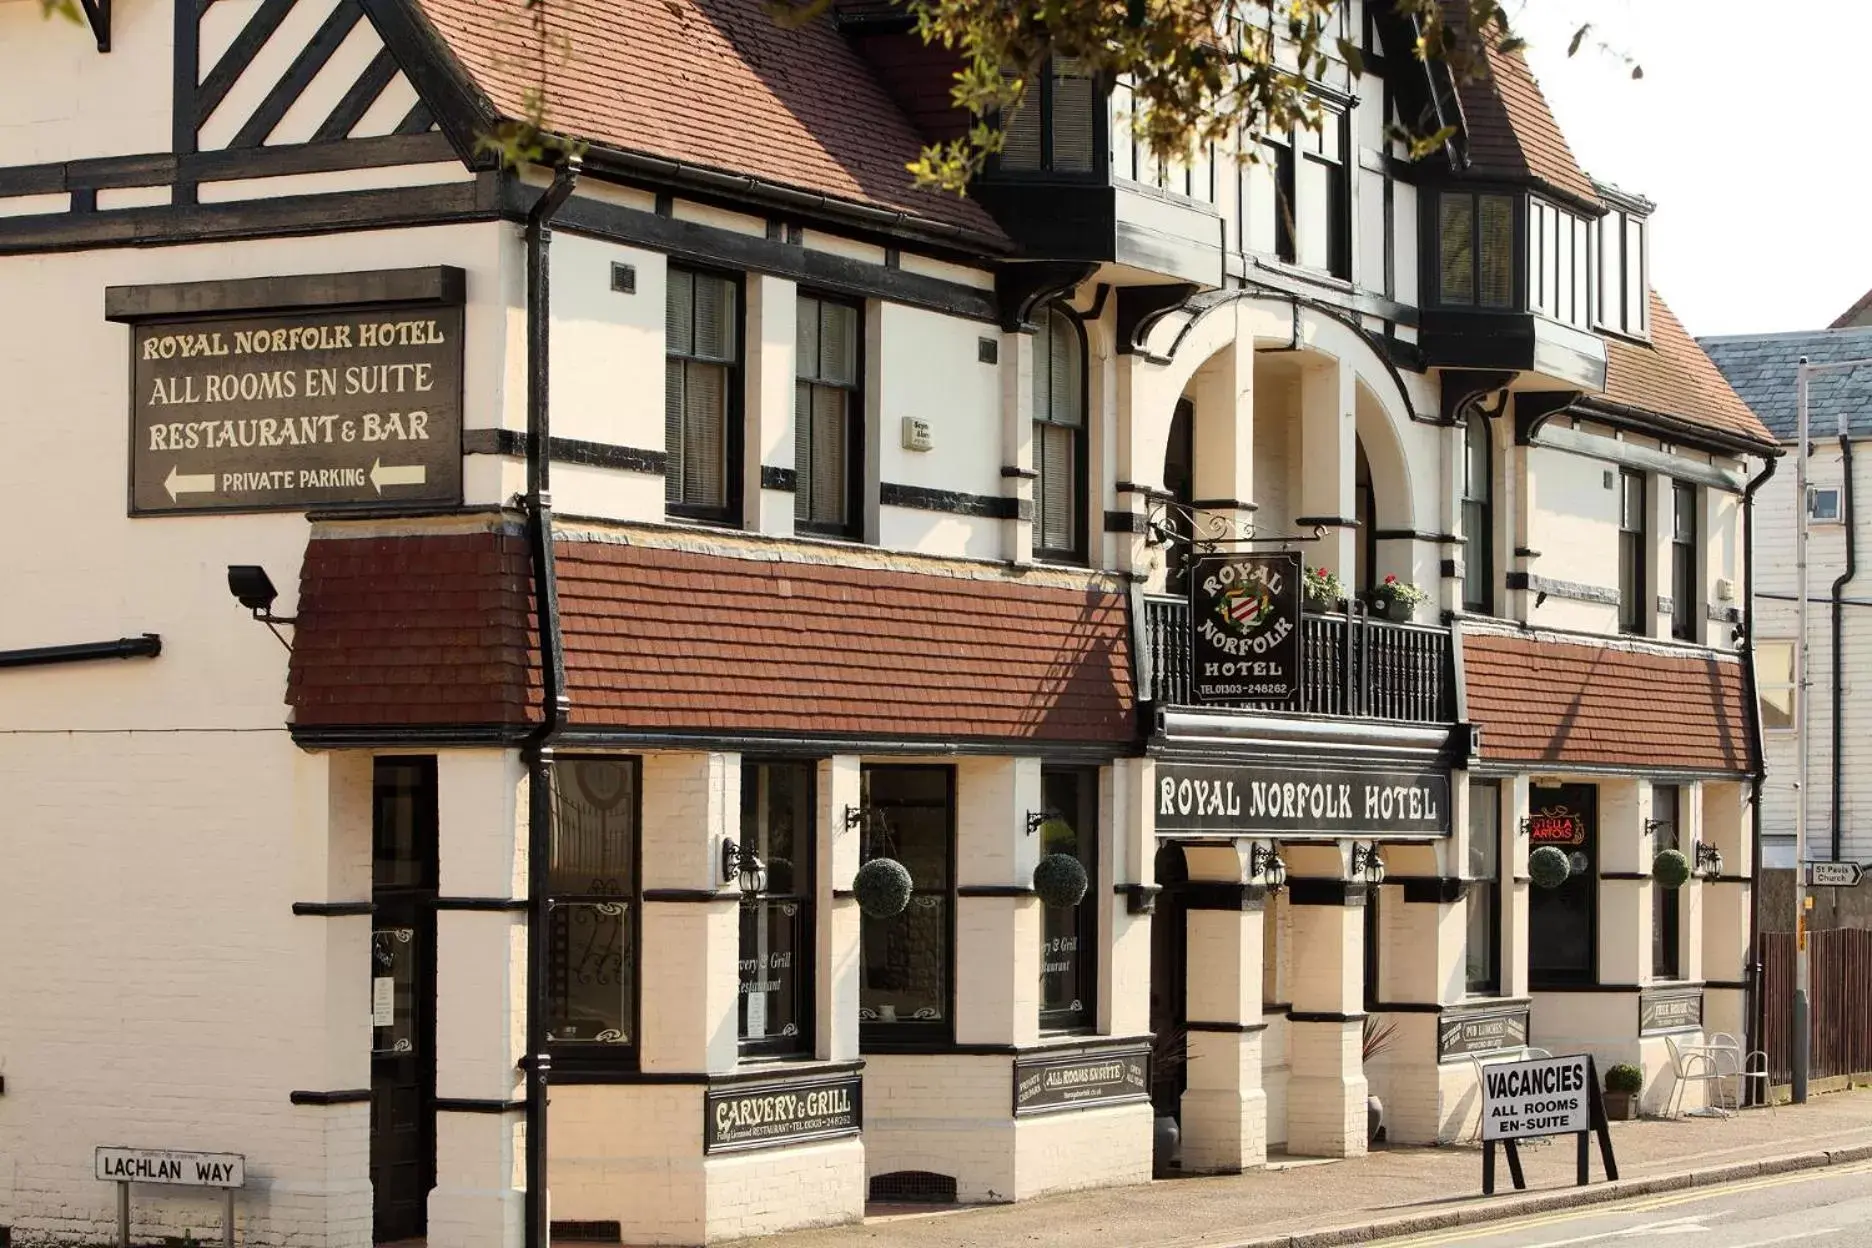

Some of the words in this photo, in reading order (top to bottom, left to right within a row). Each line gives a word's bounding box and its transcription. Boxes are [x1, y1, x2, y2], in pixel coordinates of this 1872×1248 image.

[143, 333, 229, 361] ROYAL
[234, 325, 352, 355] NORFOLK
[358, 320, 445, 347] HOTEL
[148, 377, 201, 406] ALL
[205, 371, 297, 403] ROOMS
[305, 368, 337, 397] EN
[344, 363, 434, 394] SUITE
[149, 414, 340, 451] RESTAURANT
[341, 420, 357, 442] &
[362, 410, 430, 441] BAR
[222, 470, 295, 492] PRIVATE
[299, 468, 366, 489] PARKING
[1202, 562, 1283, 597] ROYAL
[1197, 616, 1293, 656] NORFOLK
[1204, 661, 1282, 677] HOTEL
[1160, 776, 1240, 816] ROYAL
[1250, 781, 1353, 818] NORFOLK
[1364, 785, 1437, 820] HOTEL
[1533, 828, 1572, 838] ARTOIS
[1816, 865, 1825, 873] St
[1818, 874, 1846, 882] Church
[770, 952, 791, 968] Grill
[1046, 1071, 1062, 1087] ALL
[1063, 1069, 1089, 1084] ROOMS
[1487, 1064, 1583, 1099] VACANCIES
[716, 1094, 797, 1133] CARVERY
[797, 1101, 805, 1118] &
[807, 1088, 851, 1116] GRILL
[1491, 1105, 1518, 1117] ALL
[1524, 1098, 1578, 1114] ROOMS
[752, 1124, 790, 1138] RESTAURANT
[1499, 1115, 1569, 1133] EN-SUITE
[104, 1157, 181, 1179] LACHLAN
[196, 1162, 234, 1182] WAY
